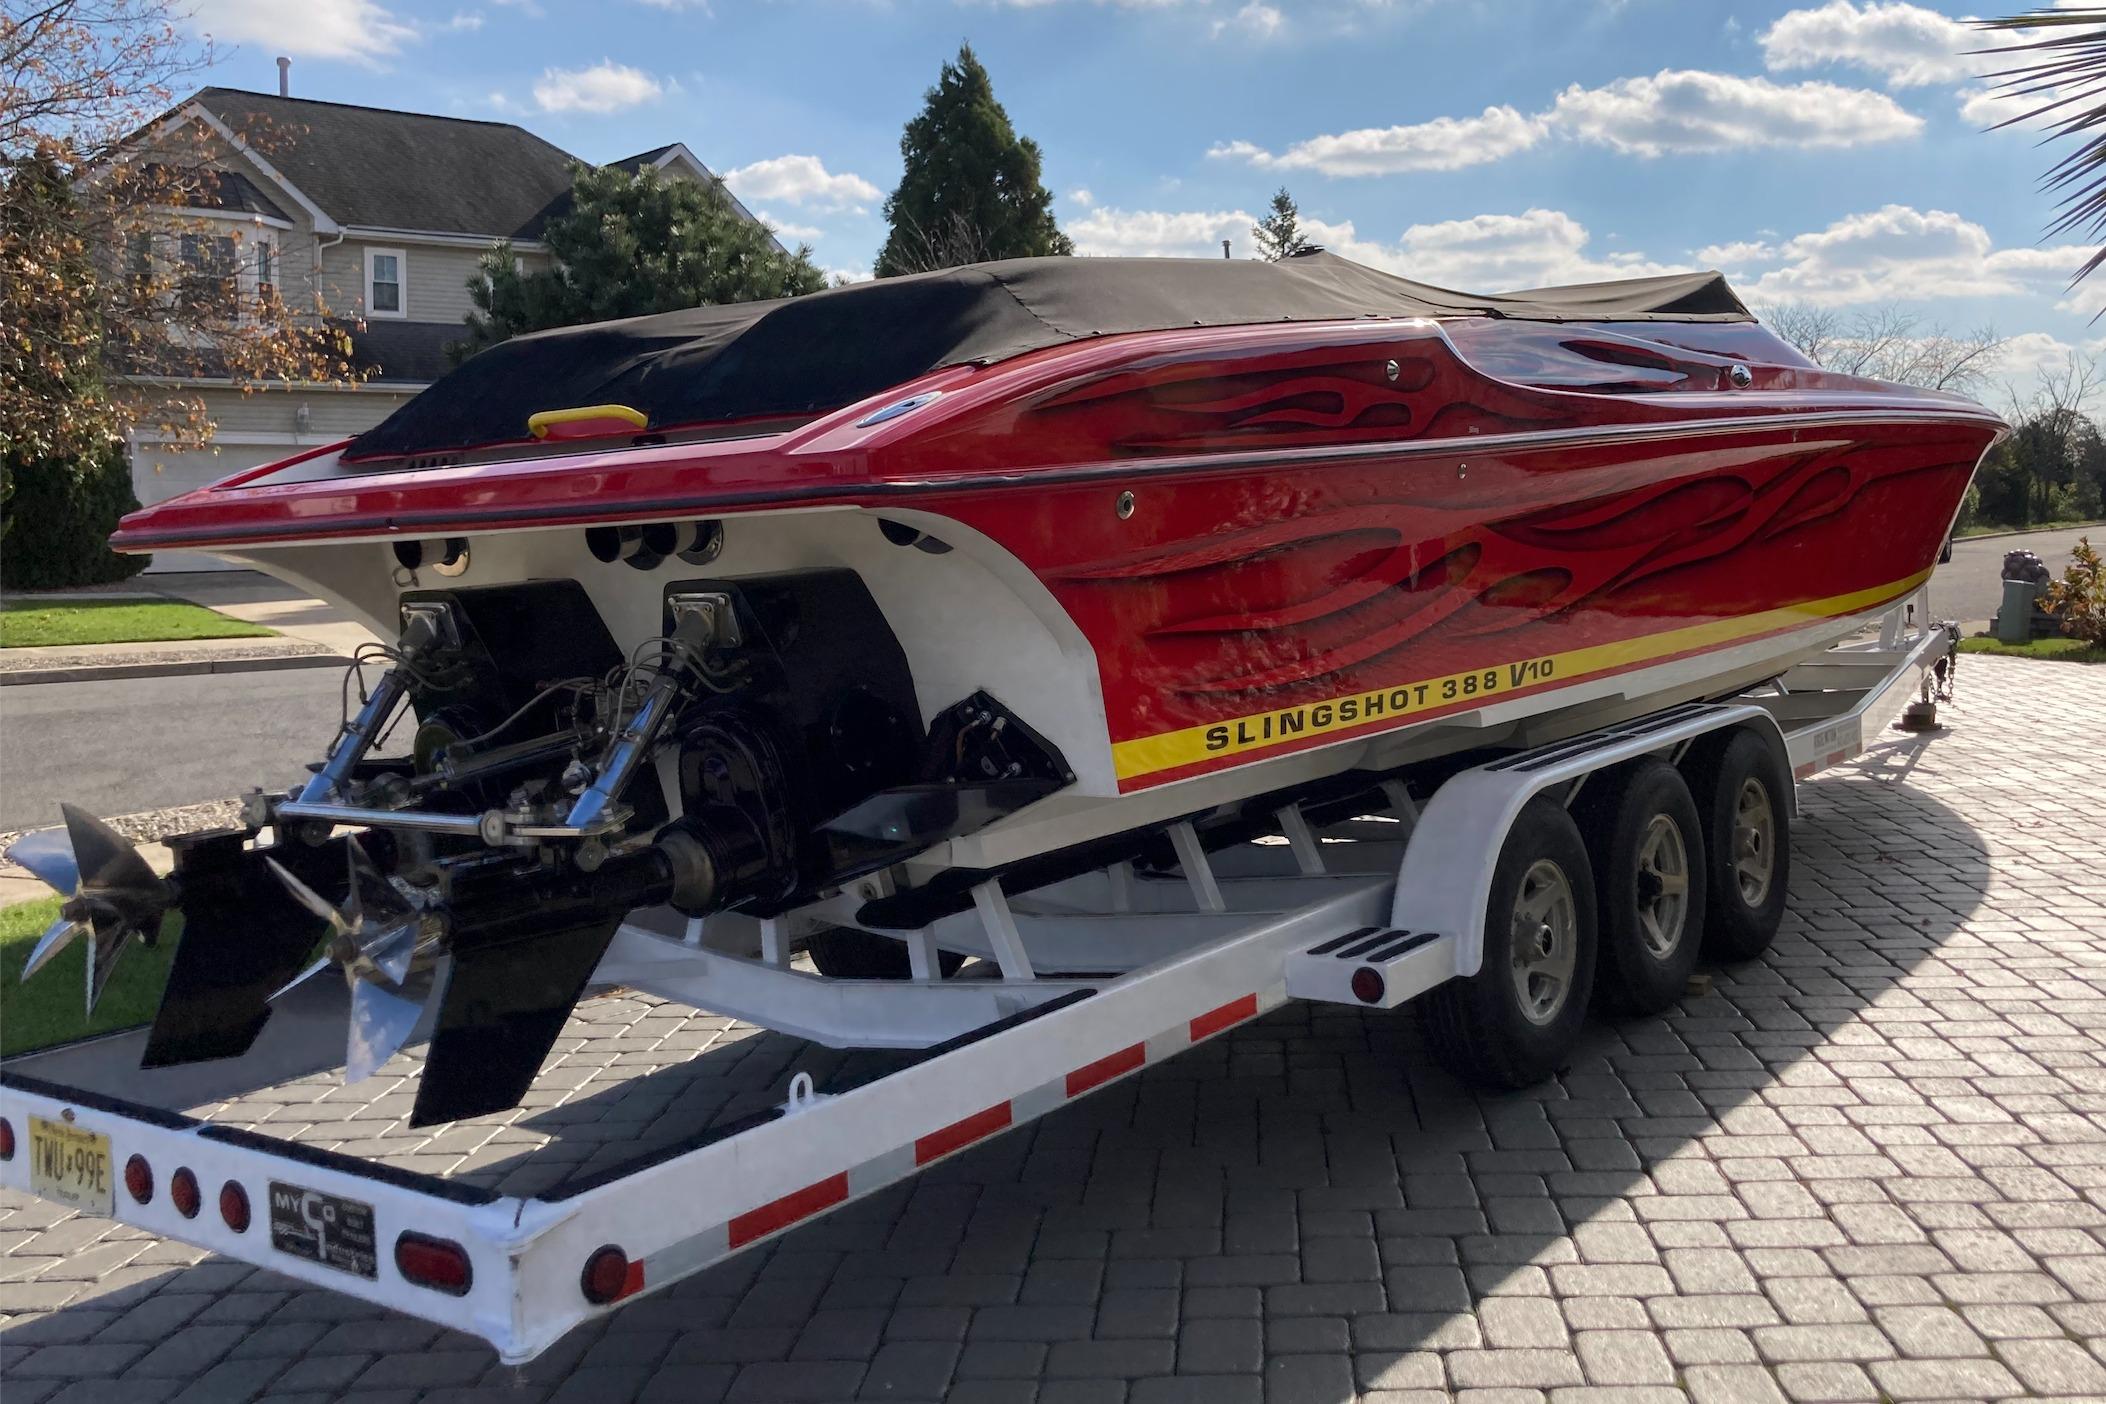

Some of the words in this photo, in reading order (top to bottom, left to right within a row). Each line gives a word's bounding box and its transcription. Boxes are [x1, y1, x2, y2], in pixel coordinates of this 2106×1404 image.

[1206, 685, 1429, 751] SLINGSHOT
[1442, 671, 1497, 699] 388
[1510, 659, 1554, 688] V10
